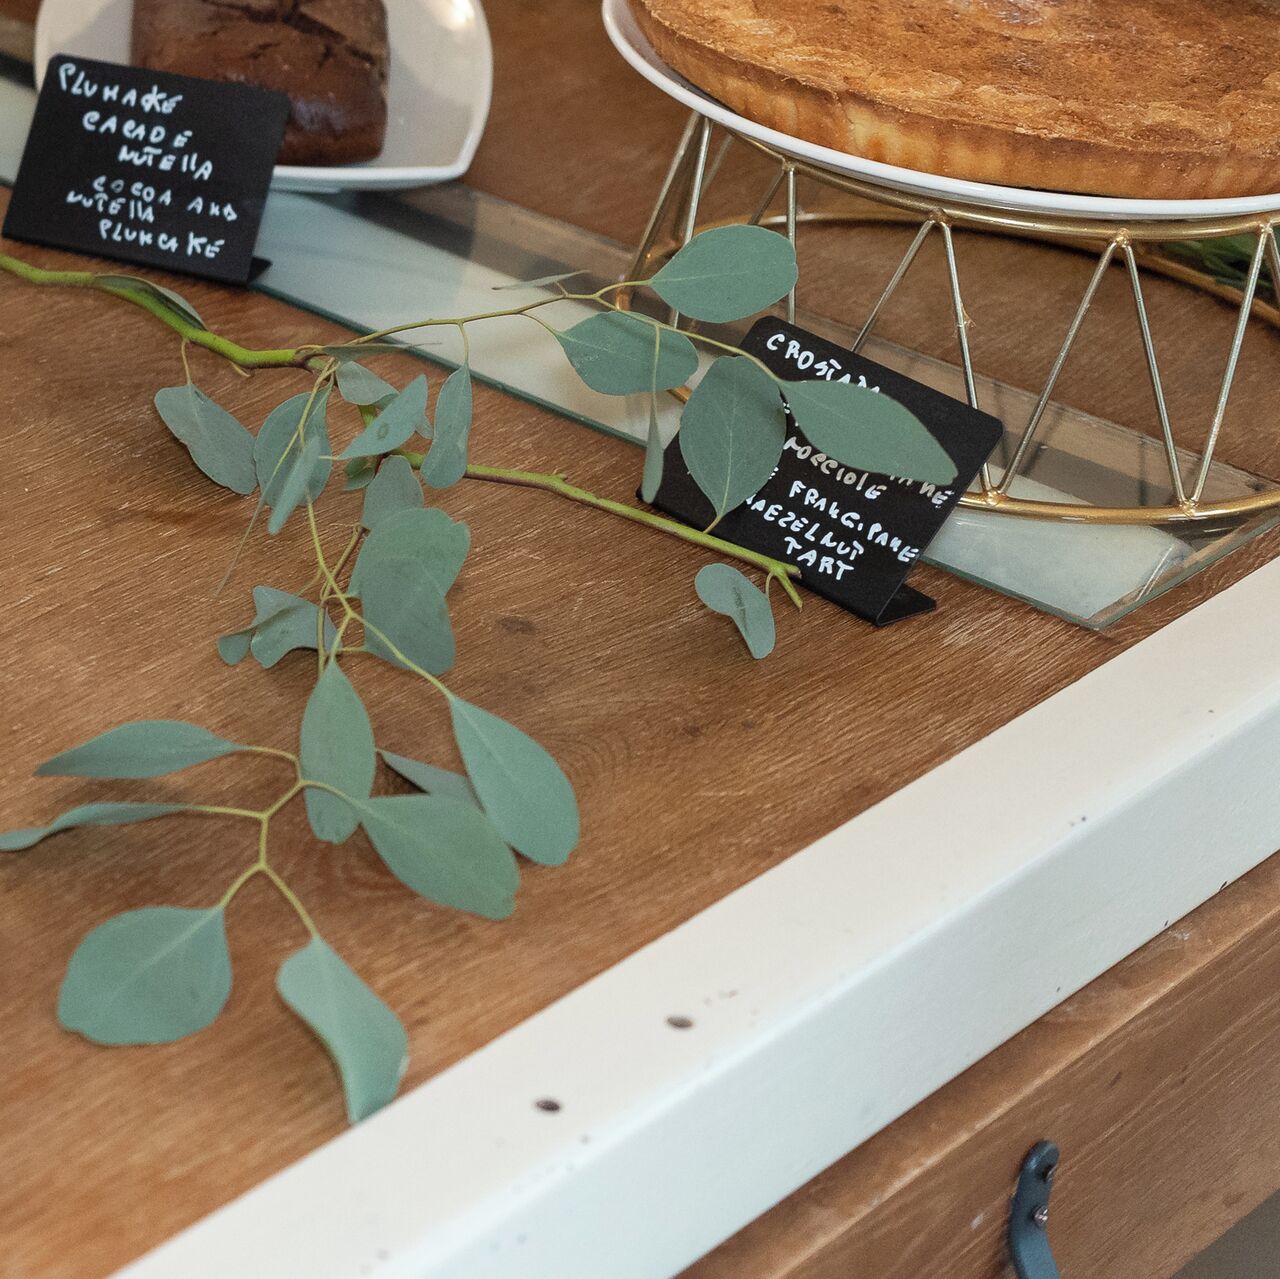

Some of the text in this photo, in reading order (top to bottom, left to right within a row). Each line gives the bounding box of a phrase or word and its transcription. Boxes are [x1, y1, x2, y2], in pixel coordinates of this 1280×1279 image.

[92, 175, 238, 222] COCOA AND
[784, 536, 855, 581] TART
